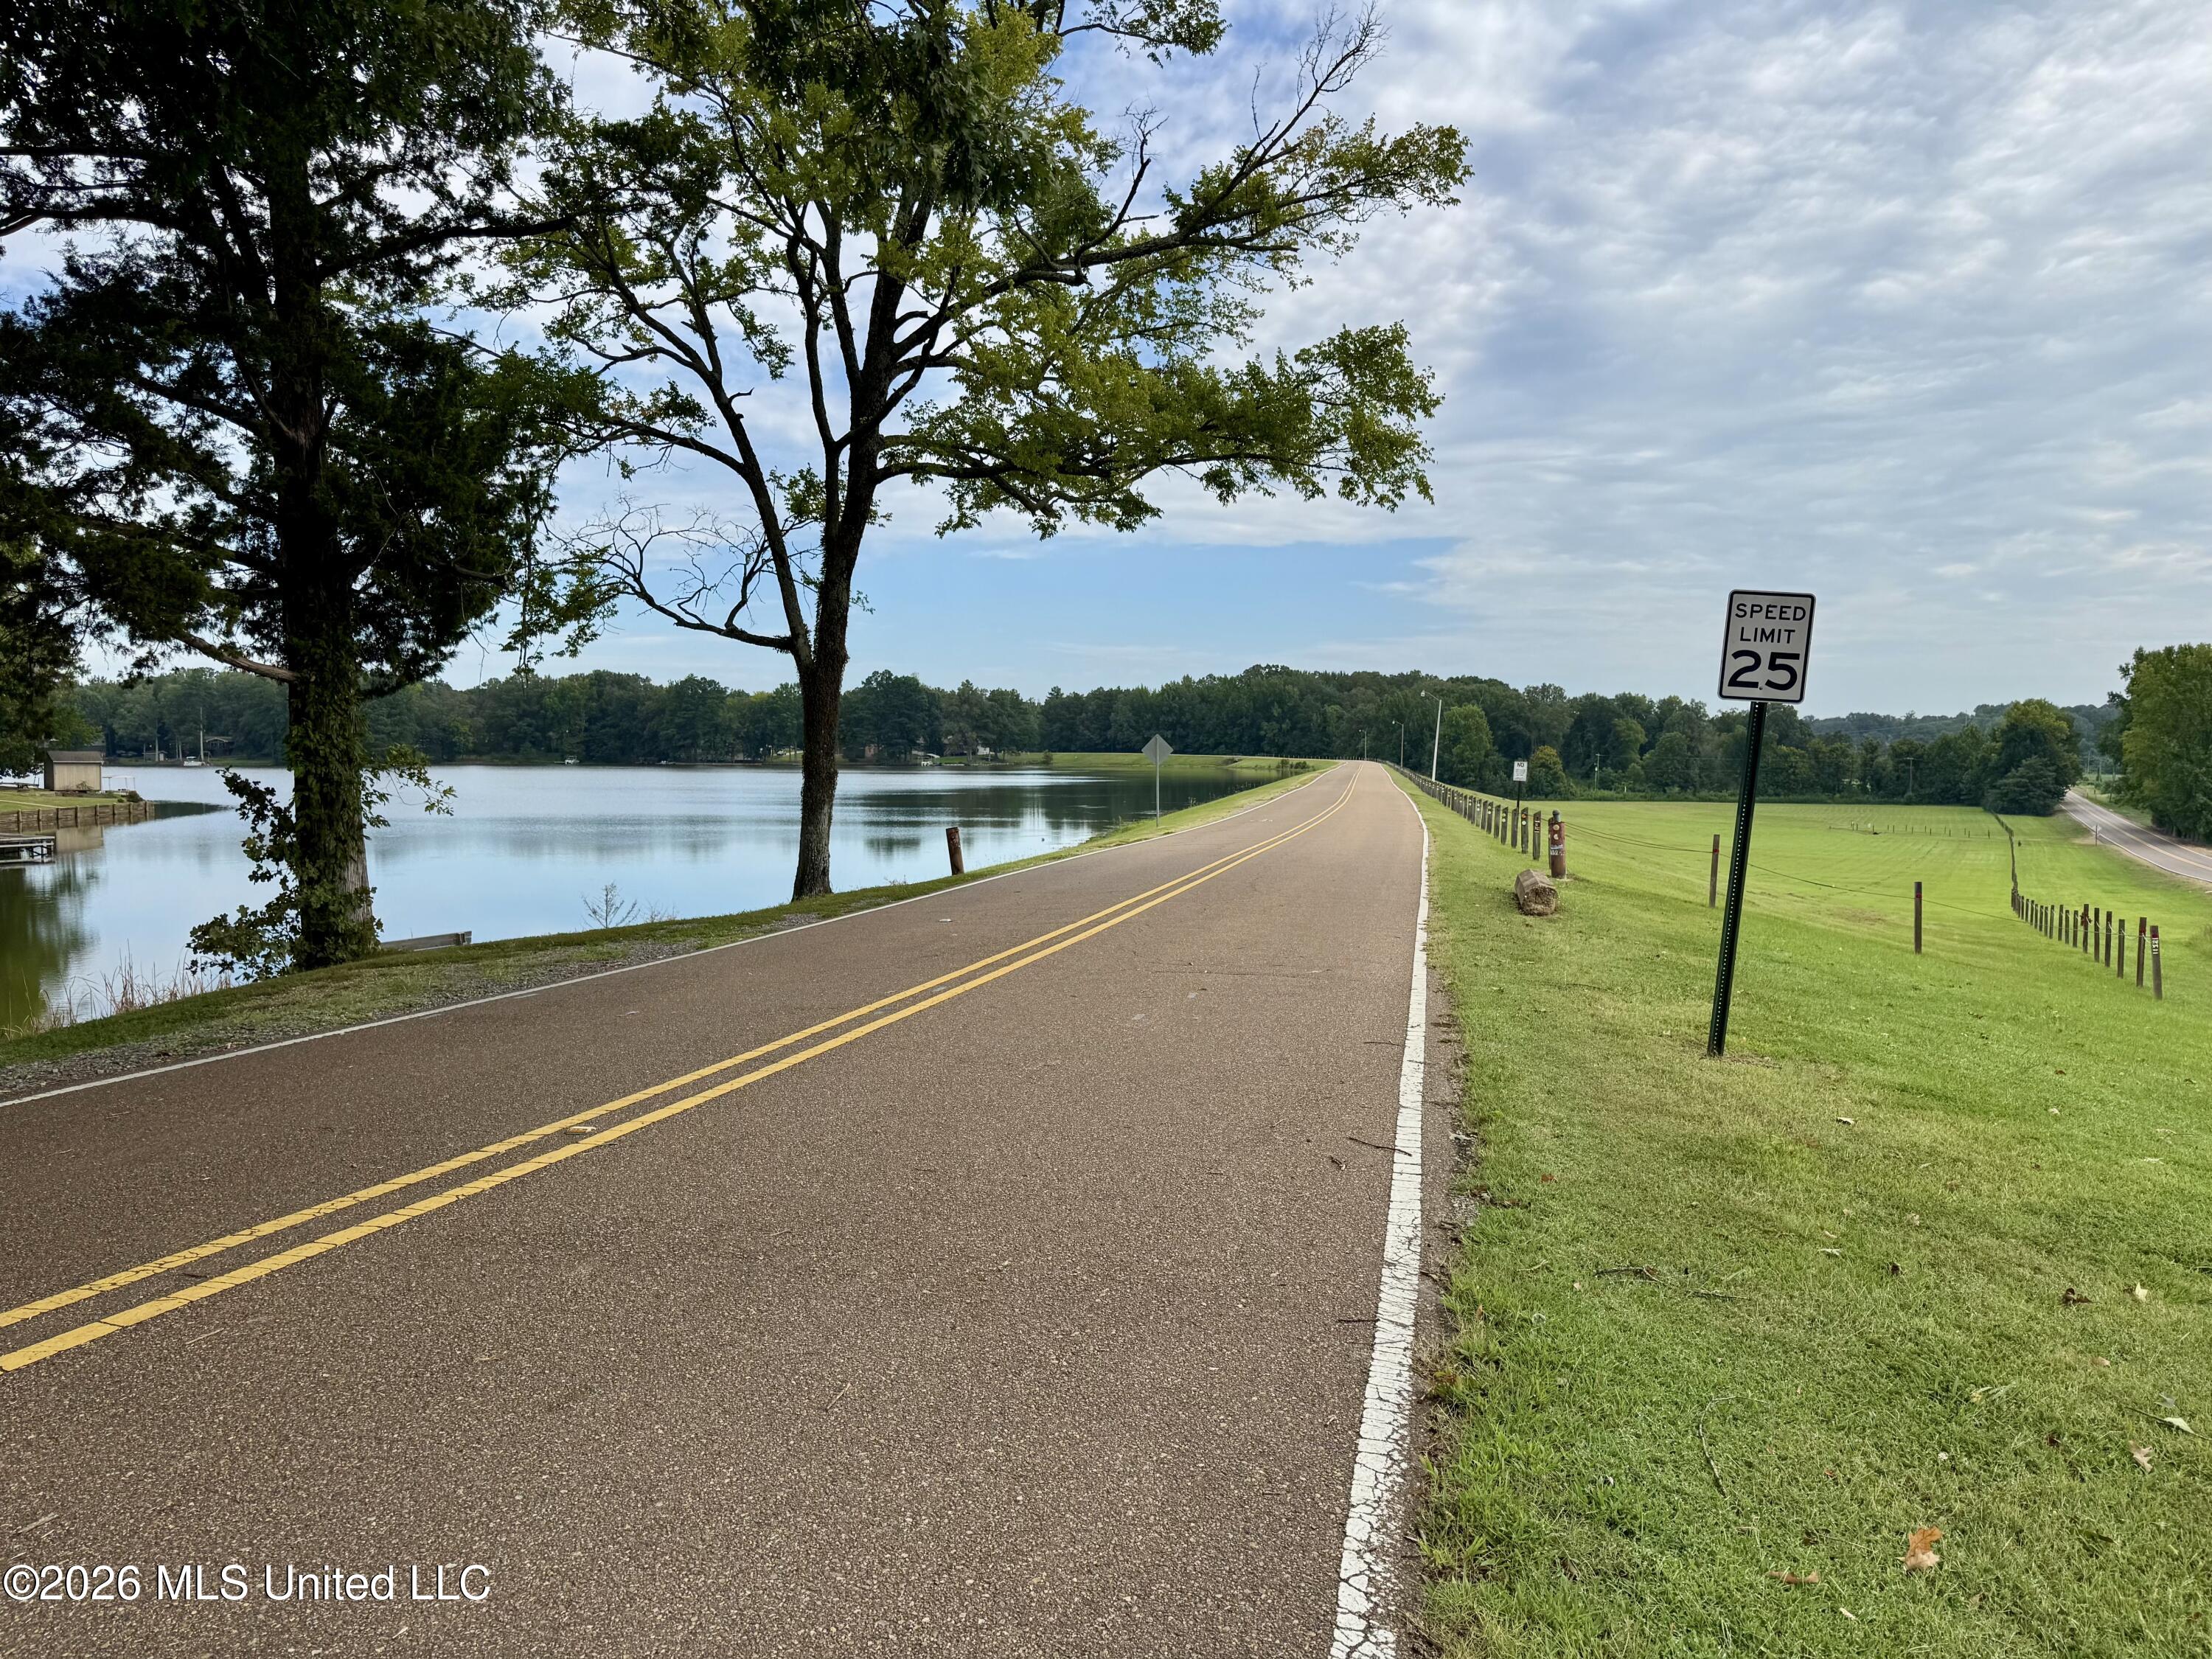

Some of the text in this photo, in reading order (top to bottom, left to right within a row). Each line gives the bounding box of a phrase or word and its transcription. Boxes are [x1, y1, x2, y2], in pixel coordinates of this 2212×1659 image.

[1735, 603, 1806, 621] SPEED
[1740, 627, 1795, 644] LIMIT
[1728, 650, 1800, 691] 25
